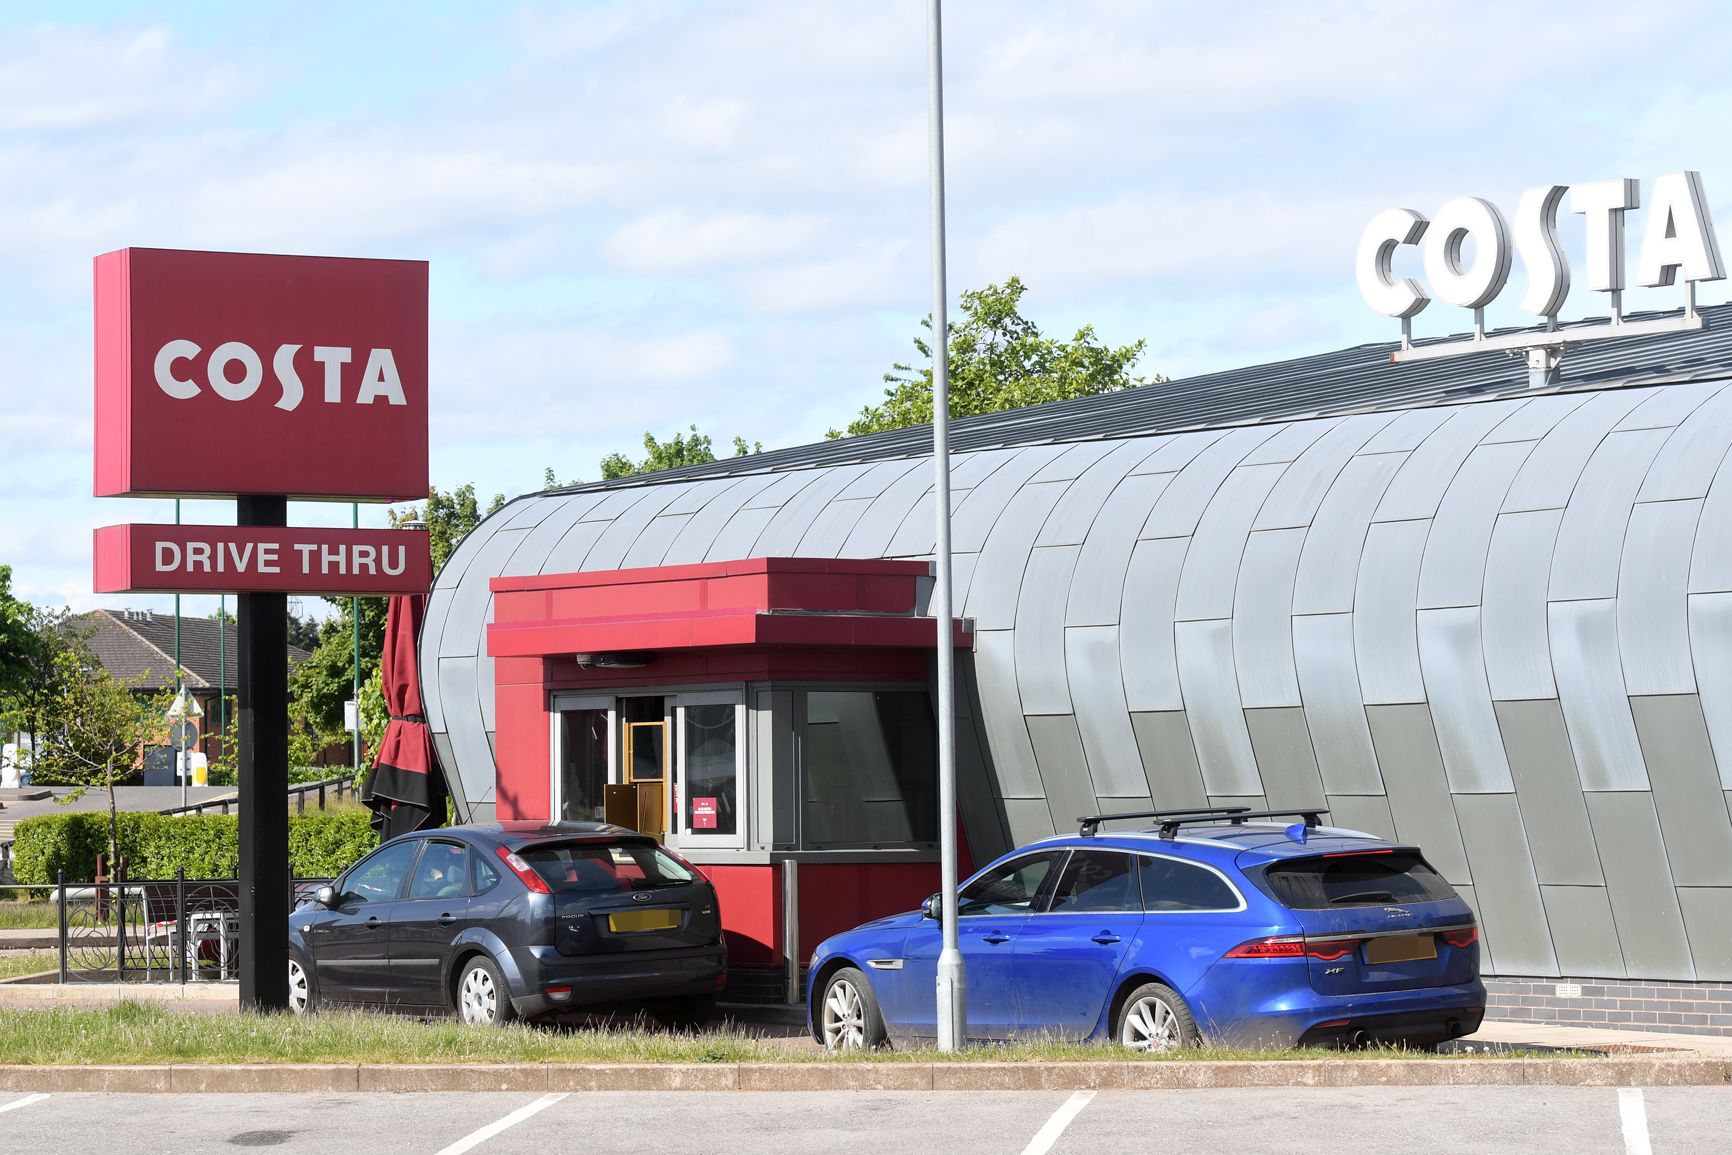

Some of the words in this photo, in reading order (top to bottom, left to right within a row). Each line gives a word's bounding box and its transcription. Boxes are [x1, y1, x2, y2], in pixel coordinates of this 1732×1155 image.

[1356, 170, 1727, 319] COSTA
[154, 339, 407, 412] COSTA
[155, 541, 281, 574] DRIVE
[294, 543, 406, 576] THRU
